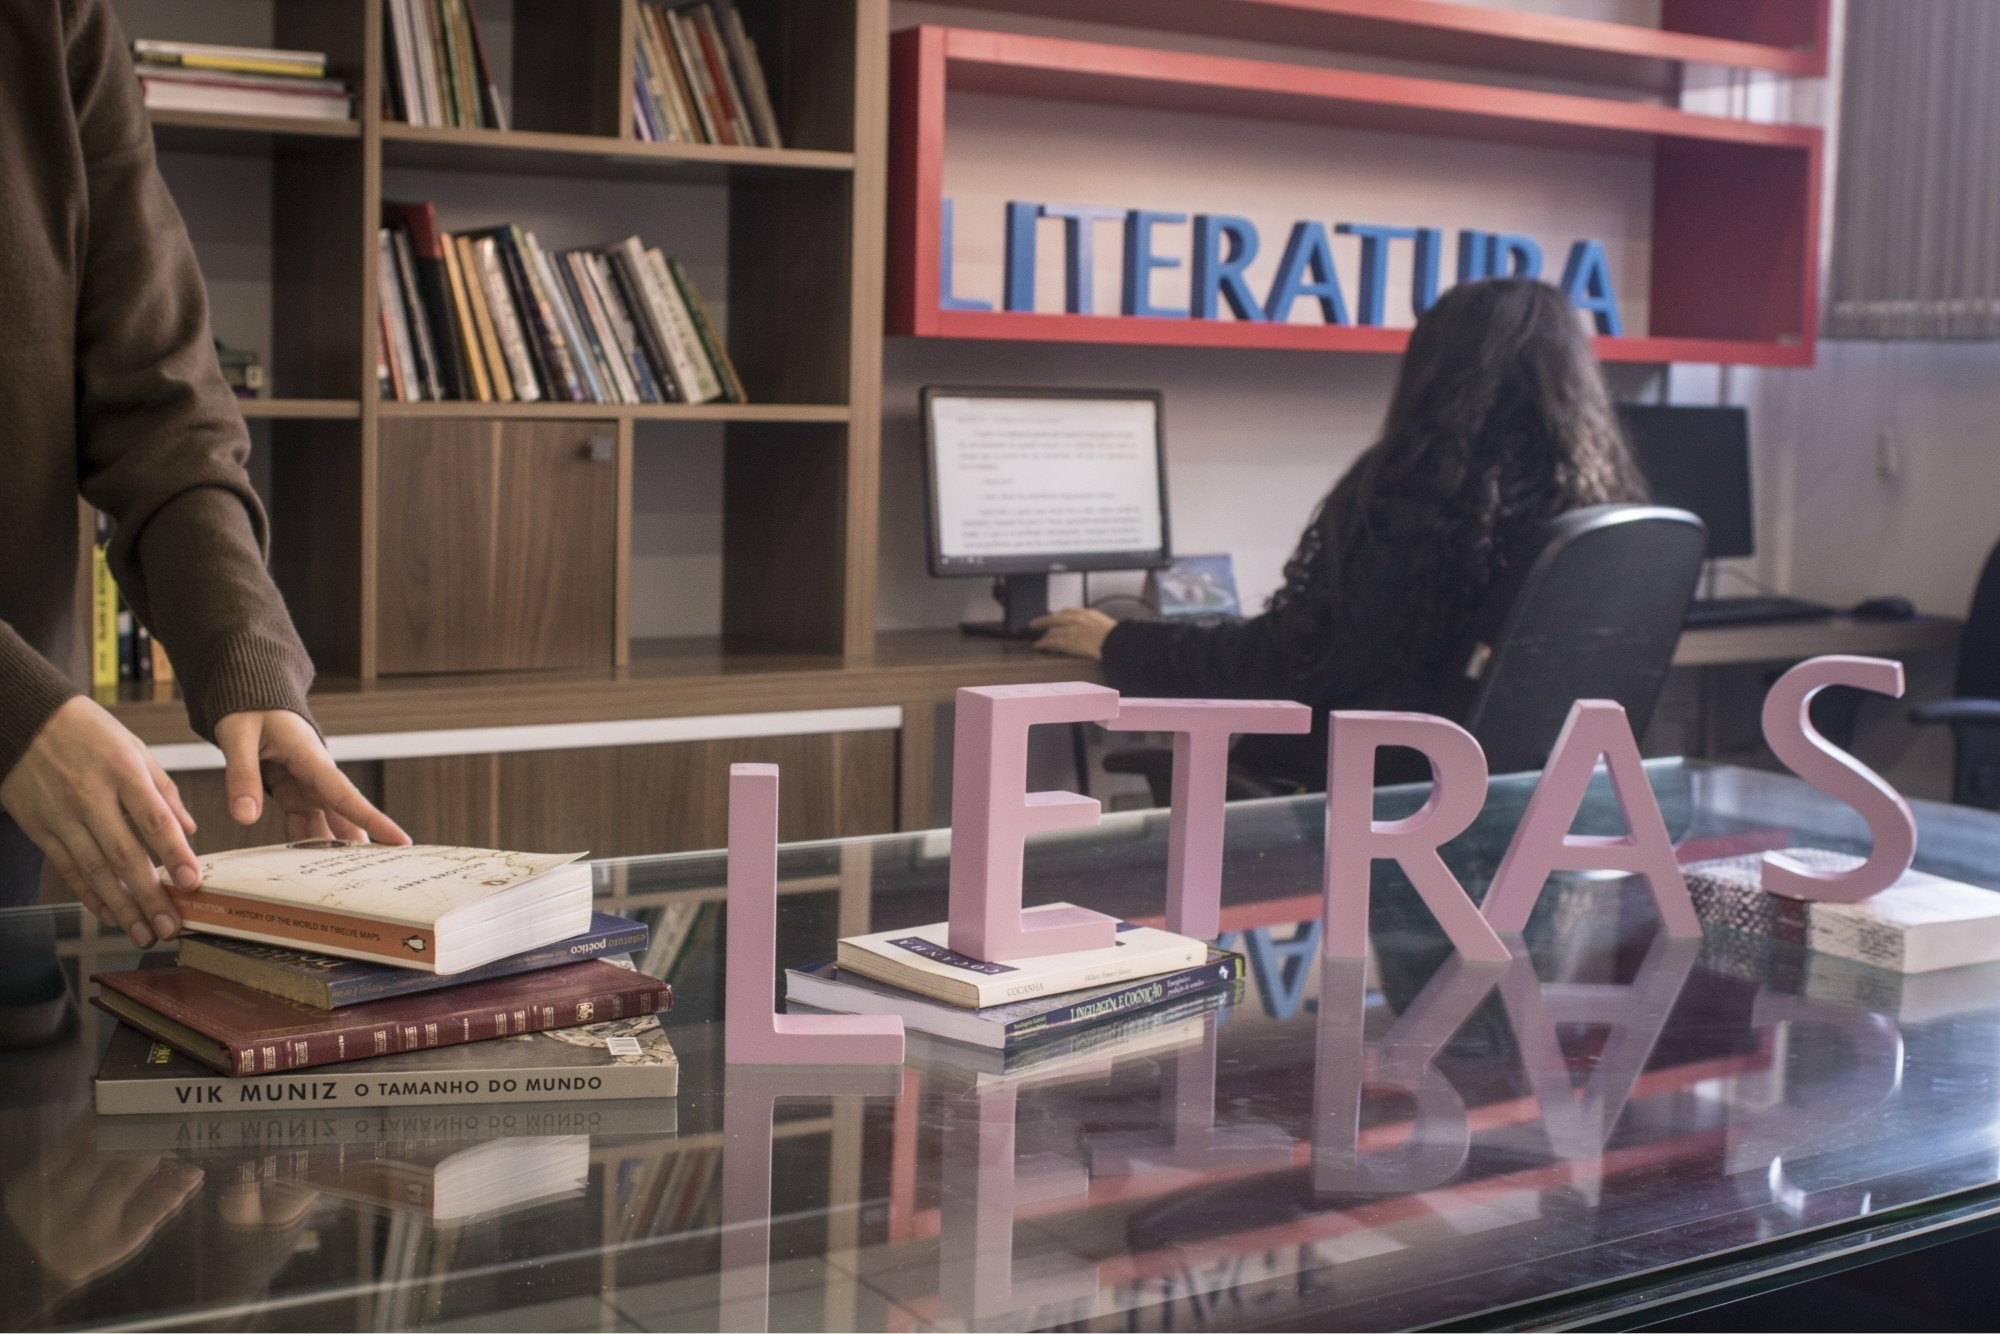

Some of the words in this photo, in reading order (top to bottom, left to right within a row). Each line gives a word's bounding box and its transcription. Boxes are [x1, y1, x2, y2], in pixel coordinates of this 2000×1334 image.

[724, 654, 1917, 1065] LETRAS
[393, 878, 428, 891] JERRY
[430, 862, 487, 880] BROTTON
[228, 907, 233, 917] A
[234, 908, 264, 922] HISTORY
[265, 913, 277, 925] OF
[278, 916, 291, 927] THE
[292, 919, 318, 931] WORLD
[320, 923, 329, 932] IN
[330, 925, 358, 938] TWELVE
[360, 930, 381, 942] MAPS
[570, 936, 607, 956] poético
[608, 933, 646, 948] estatuto
[1007, 982, 1045, 997] COCANHA
[1070, 996, 1118, 1024] LINGUAGEM
[1118, 995, 1124, 1007] E
[1124, 982, 1163, 1006] COGNIÇÃO
[175, 1085, 223, 1105] VIK
[240, 1082, 338, 1103] MUNIZ
[354, 1083, 369, 1097] O
[378, 1080, 479, 1097] TAMANHO
[488, 1077, 517, 1093] DO
[525, 1076, 602, 1092] MUNDO
